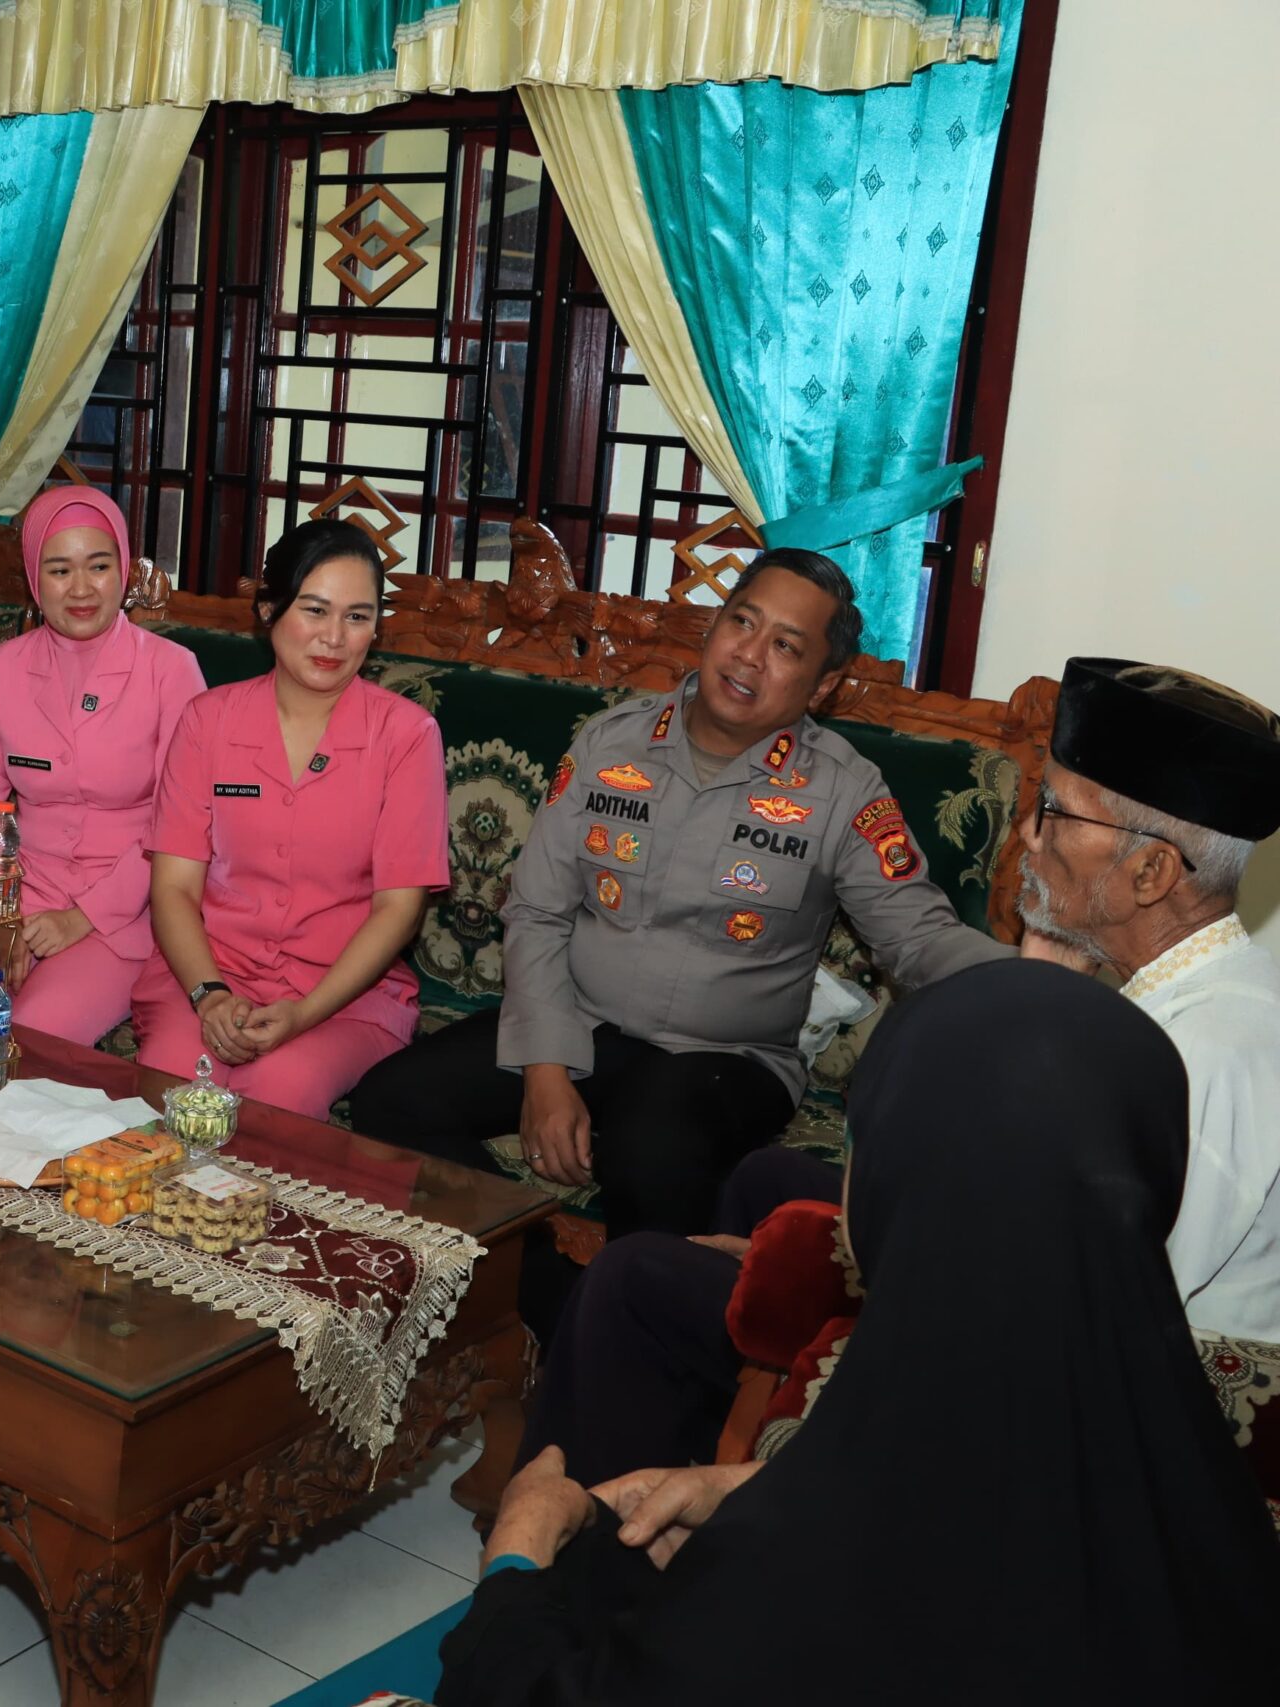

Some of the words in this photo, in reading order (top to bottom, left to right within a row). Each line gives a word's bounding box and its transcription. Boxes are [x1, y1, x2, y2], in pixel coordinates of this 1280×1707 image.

[585, 791, 650, 823] ADITHIA
[856, 801, 896, 828] POLRES
[732, 823, 809, 860] POLRI
